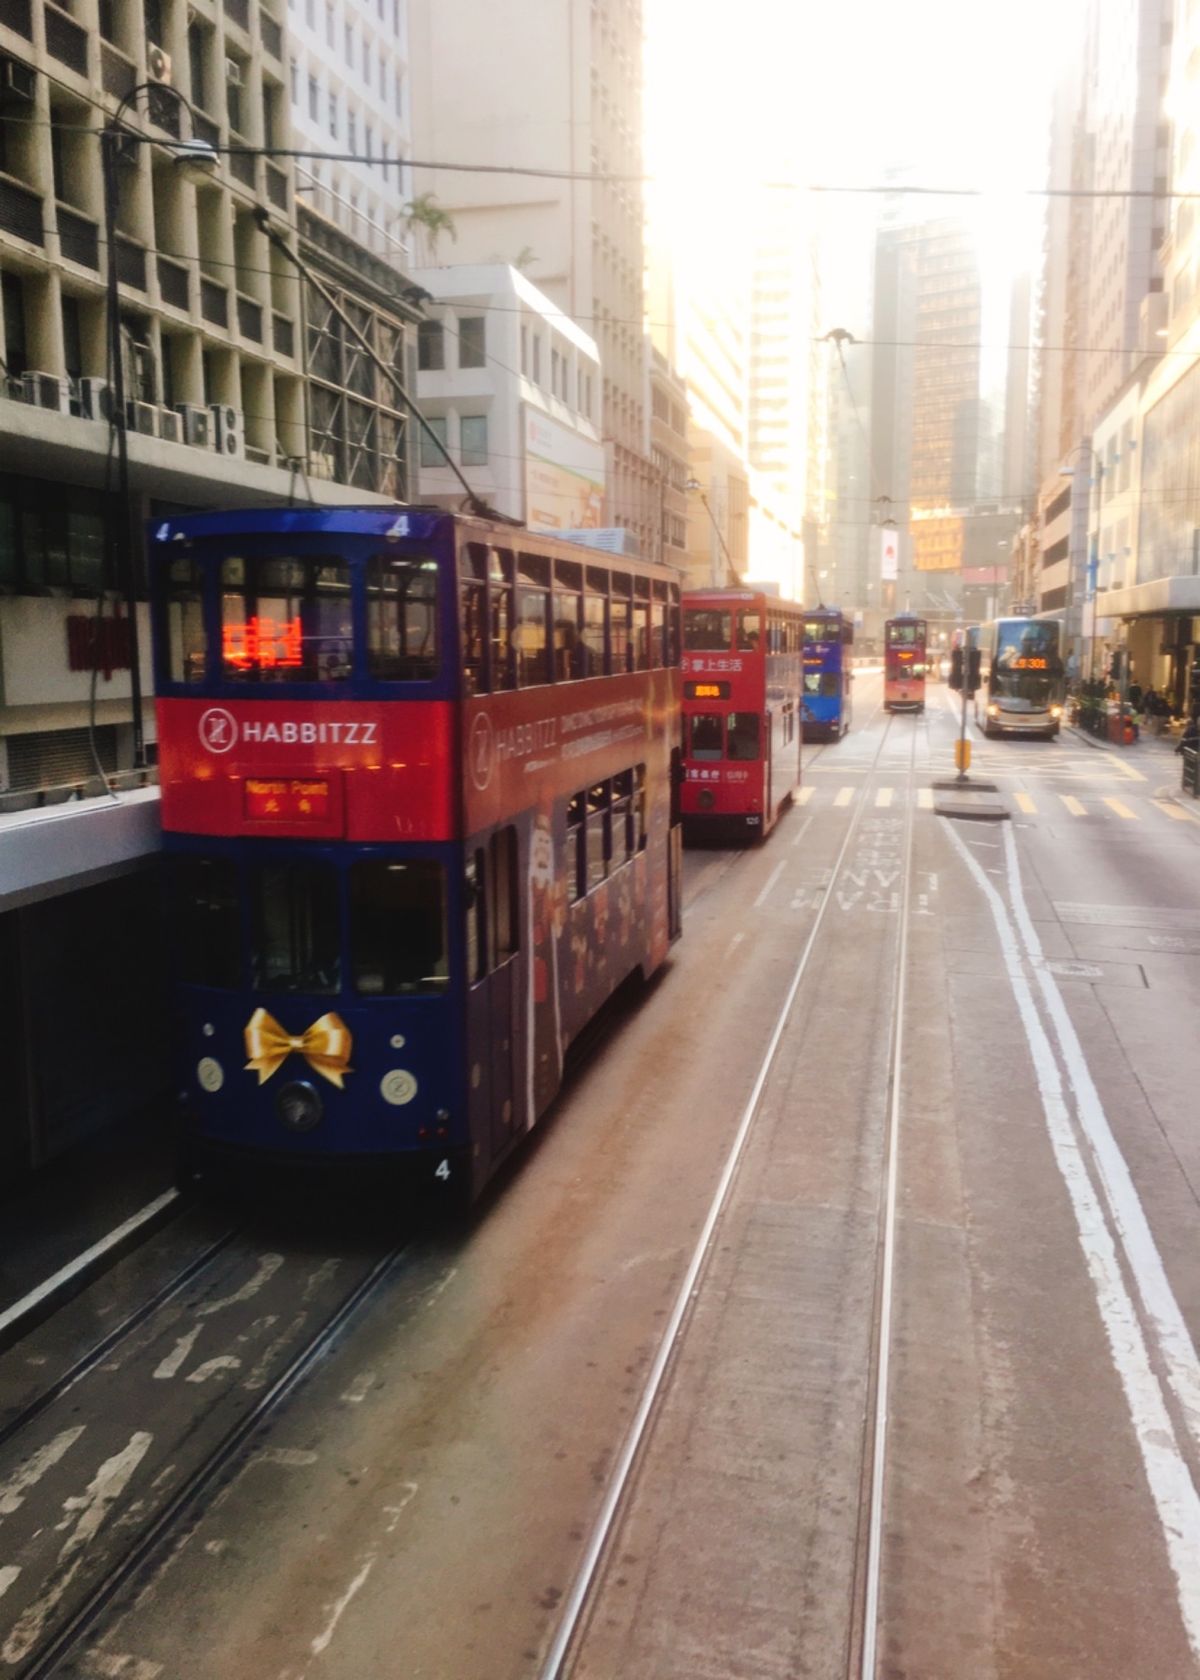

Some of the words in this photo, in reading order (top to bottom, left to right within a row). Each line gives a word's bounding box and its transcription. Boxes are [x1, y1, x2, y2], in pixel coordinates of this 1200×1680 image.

[156, 523, 170, 541] 4
[393, 515, 410, 537] 4
[692, 659, 742, 673] 掌上生活
[1028, 657, 1047, 669] 301
[243, 722, 377, 744] HABBITZZ
[246, 780, 286, 794] North
[292, 780, 328, 796] Point
[790, 887, 937, 916] TRAM
[435, 1159, 451, 1181] 4
